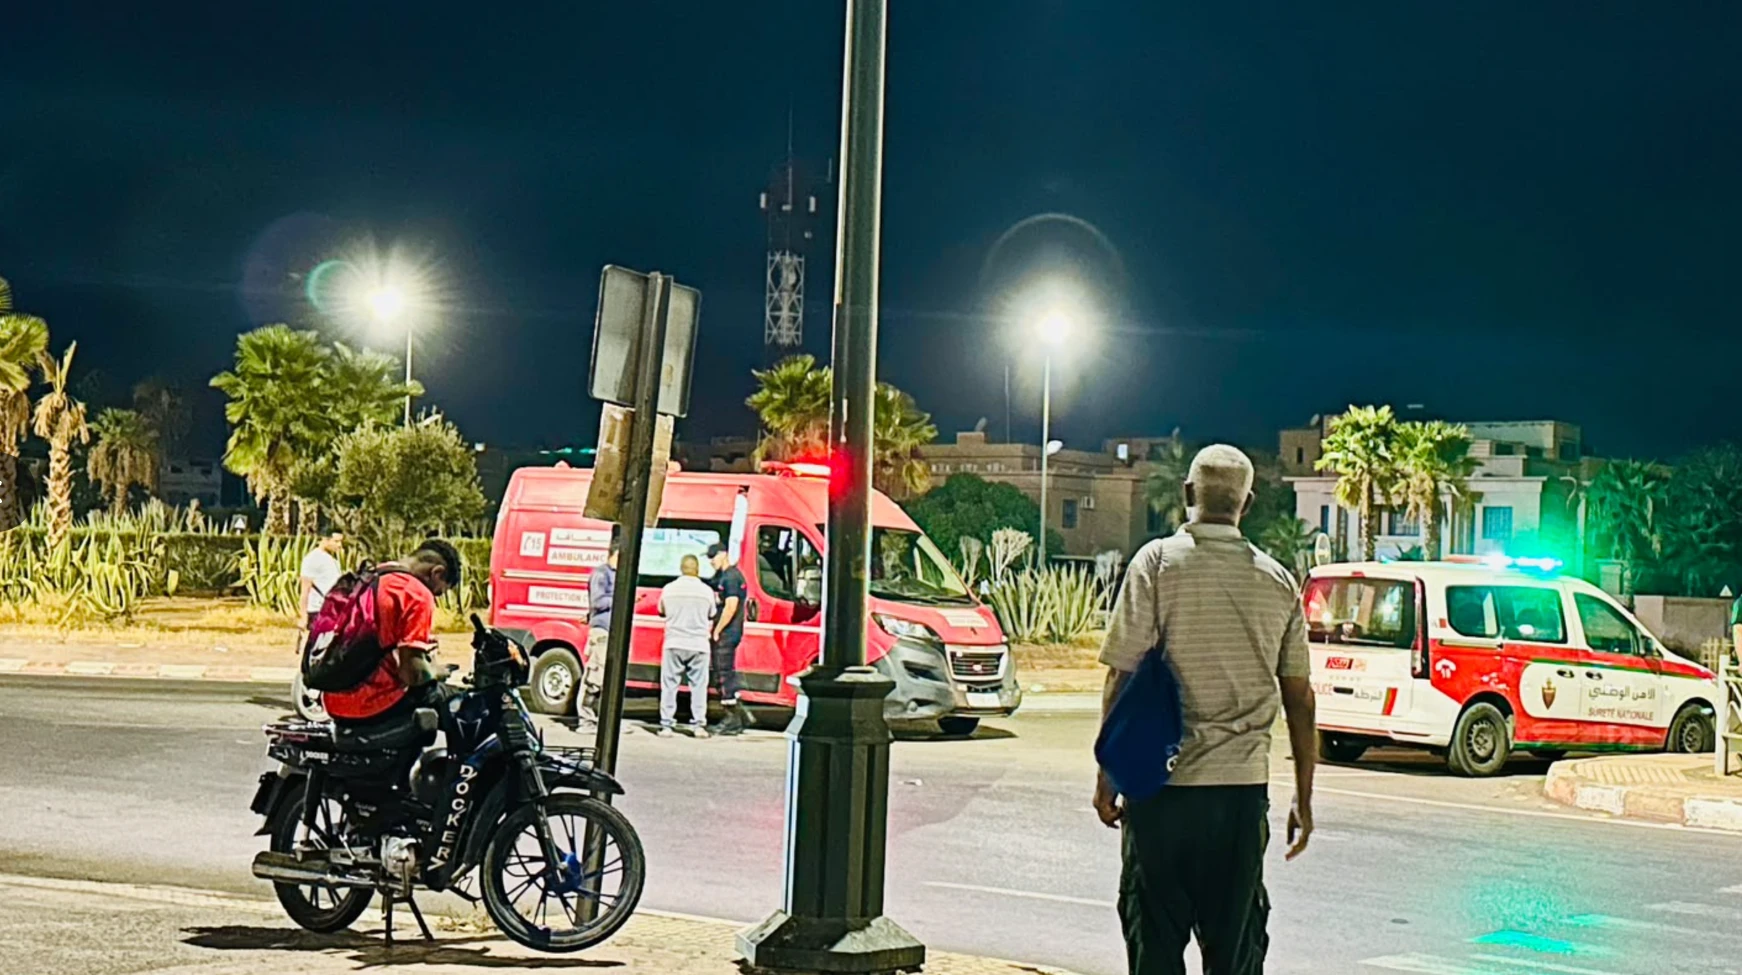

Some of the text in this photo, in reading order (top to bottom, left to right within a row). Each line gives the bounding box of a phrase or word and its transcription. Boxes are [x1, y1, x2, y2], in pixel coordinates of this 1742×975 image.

[551, 551, 606, 562] AMBULANC
[535, 590, 582, 602] PROTECTION
[1617, 708, 1654, 721] NATIONALE
